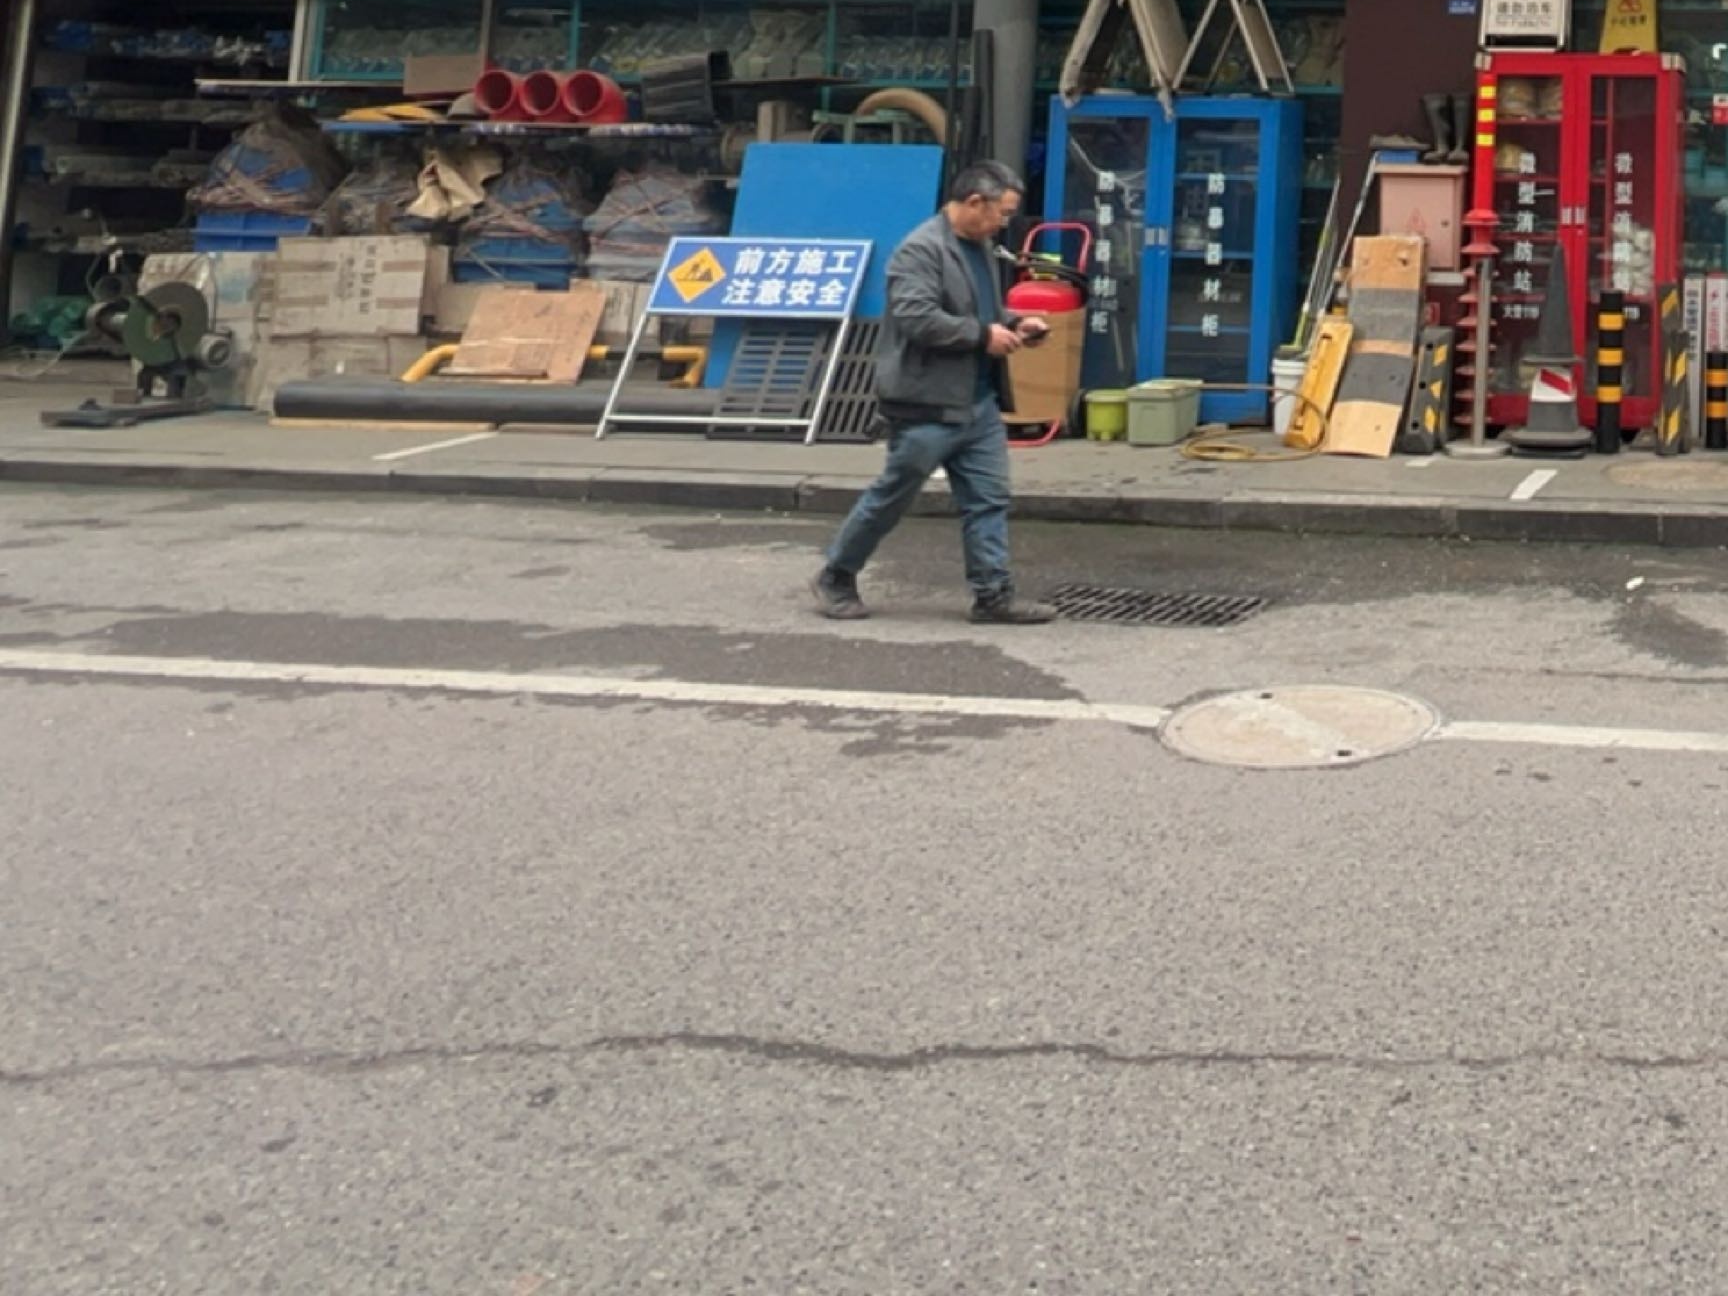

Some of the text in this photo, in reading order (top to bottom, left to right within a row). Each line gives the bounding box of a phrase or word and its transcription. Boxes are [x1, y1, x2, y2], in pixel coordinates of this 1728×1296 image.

[733, 247, 857, 275] 前方施工
[722, 278, 847, 305] 注意安全
